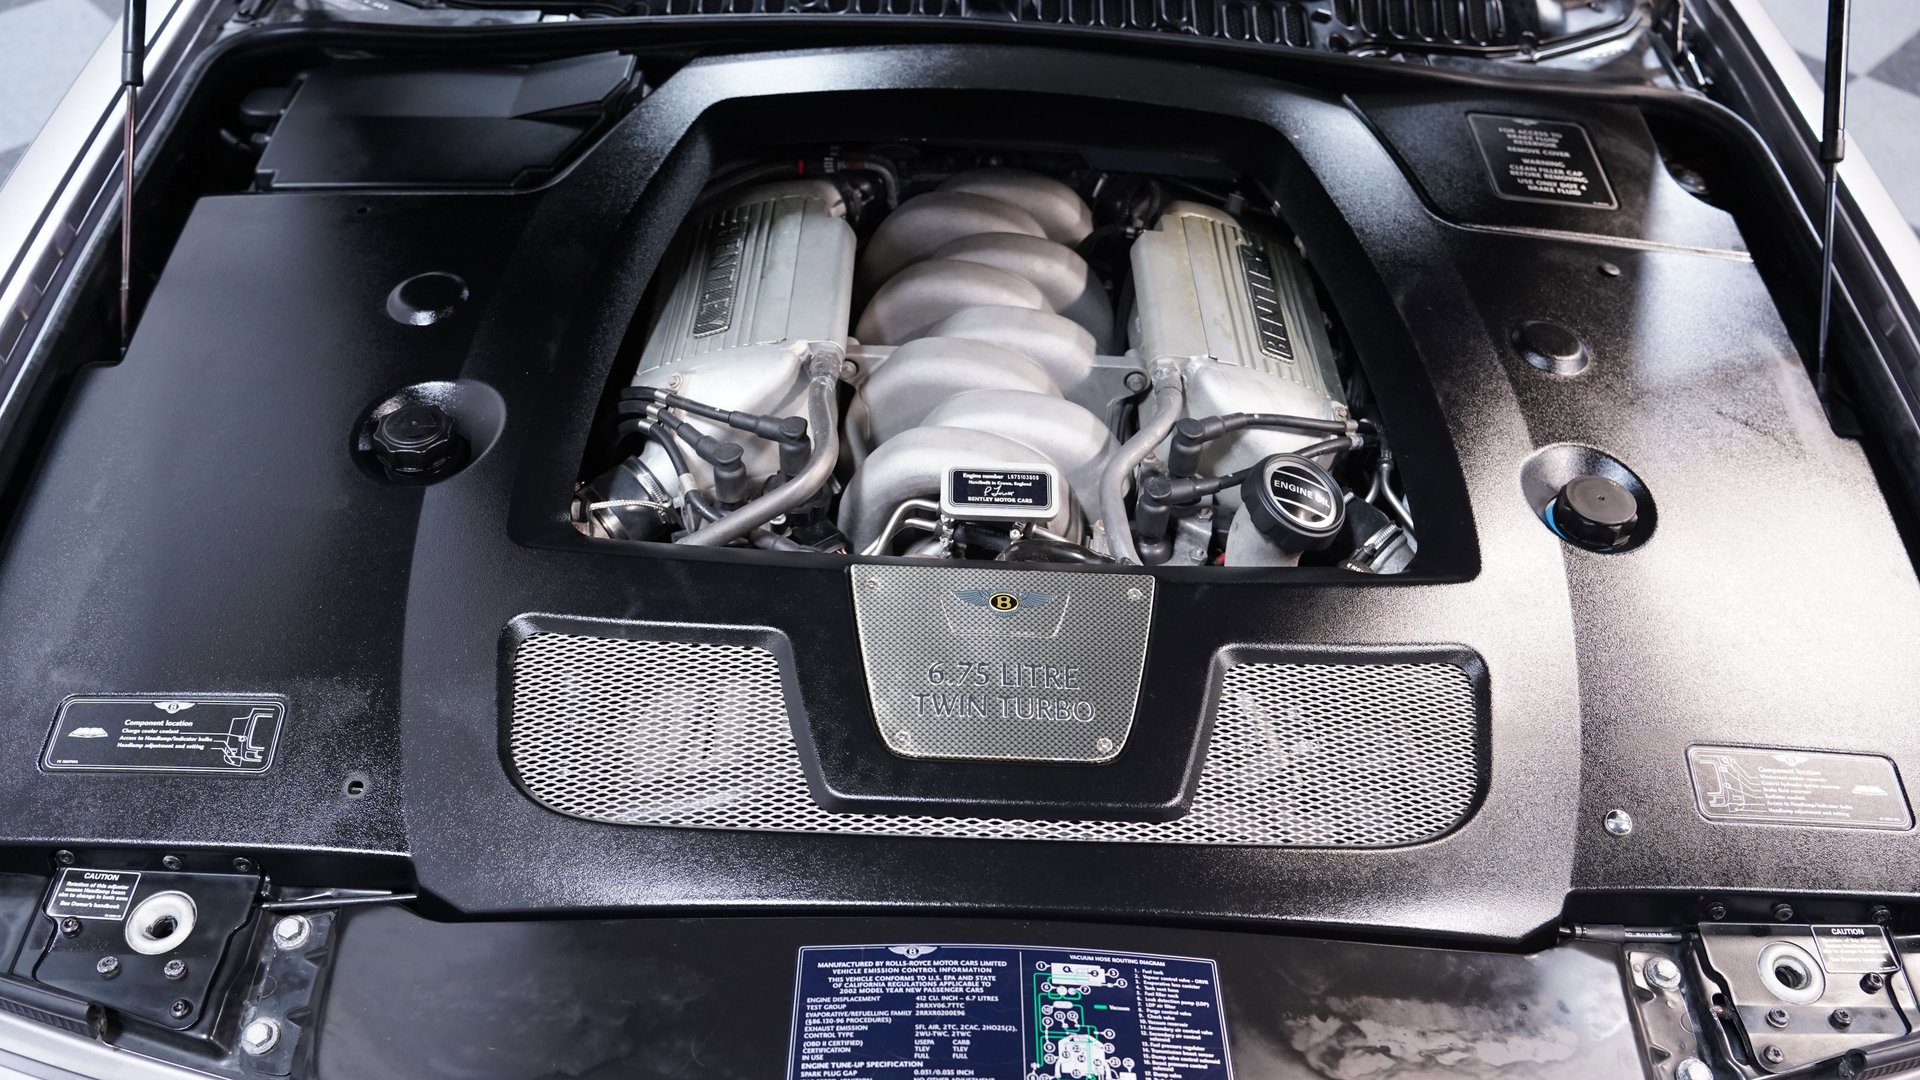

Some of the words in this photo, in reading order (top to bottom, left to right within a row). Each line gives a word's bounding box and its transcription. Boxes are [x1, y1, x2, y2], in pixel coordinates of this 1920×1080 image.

[1518, 129, 1549, 137] ACCESS
[1506, 146, 1540, 154] REMOVE
[1542, 150, 1571, 158] COVER
[1521, 158, 1566, 168] WARNING
[1543, 173, 1588, 183] REMOVING
[1528, 185, 1556, 193] BRAKE
[1557, 187, 1581, 196] FLUID
[1244, 246, 1293, 358] BENTLEY
[1274, 480, 1313, 499] ENGINE
[1314, 495, 1330, 508] OIL
[928, 661, 990, 686] 6.75
[1001, 662, 1080, 690] LITRE
[912, 693, 987, 717] TWIN
[997, 697, 1095, 722] TURBO
